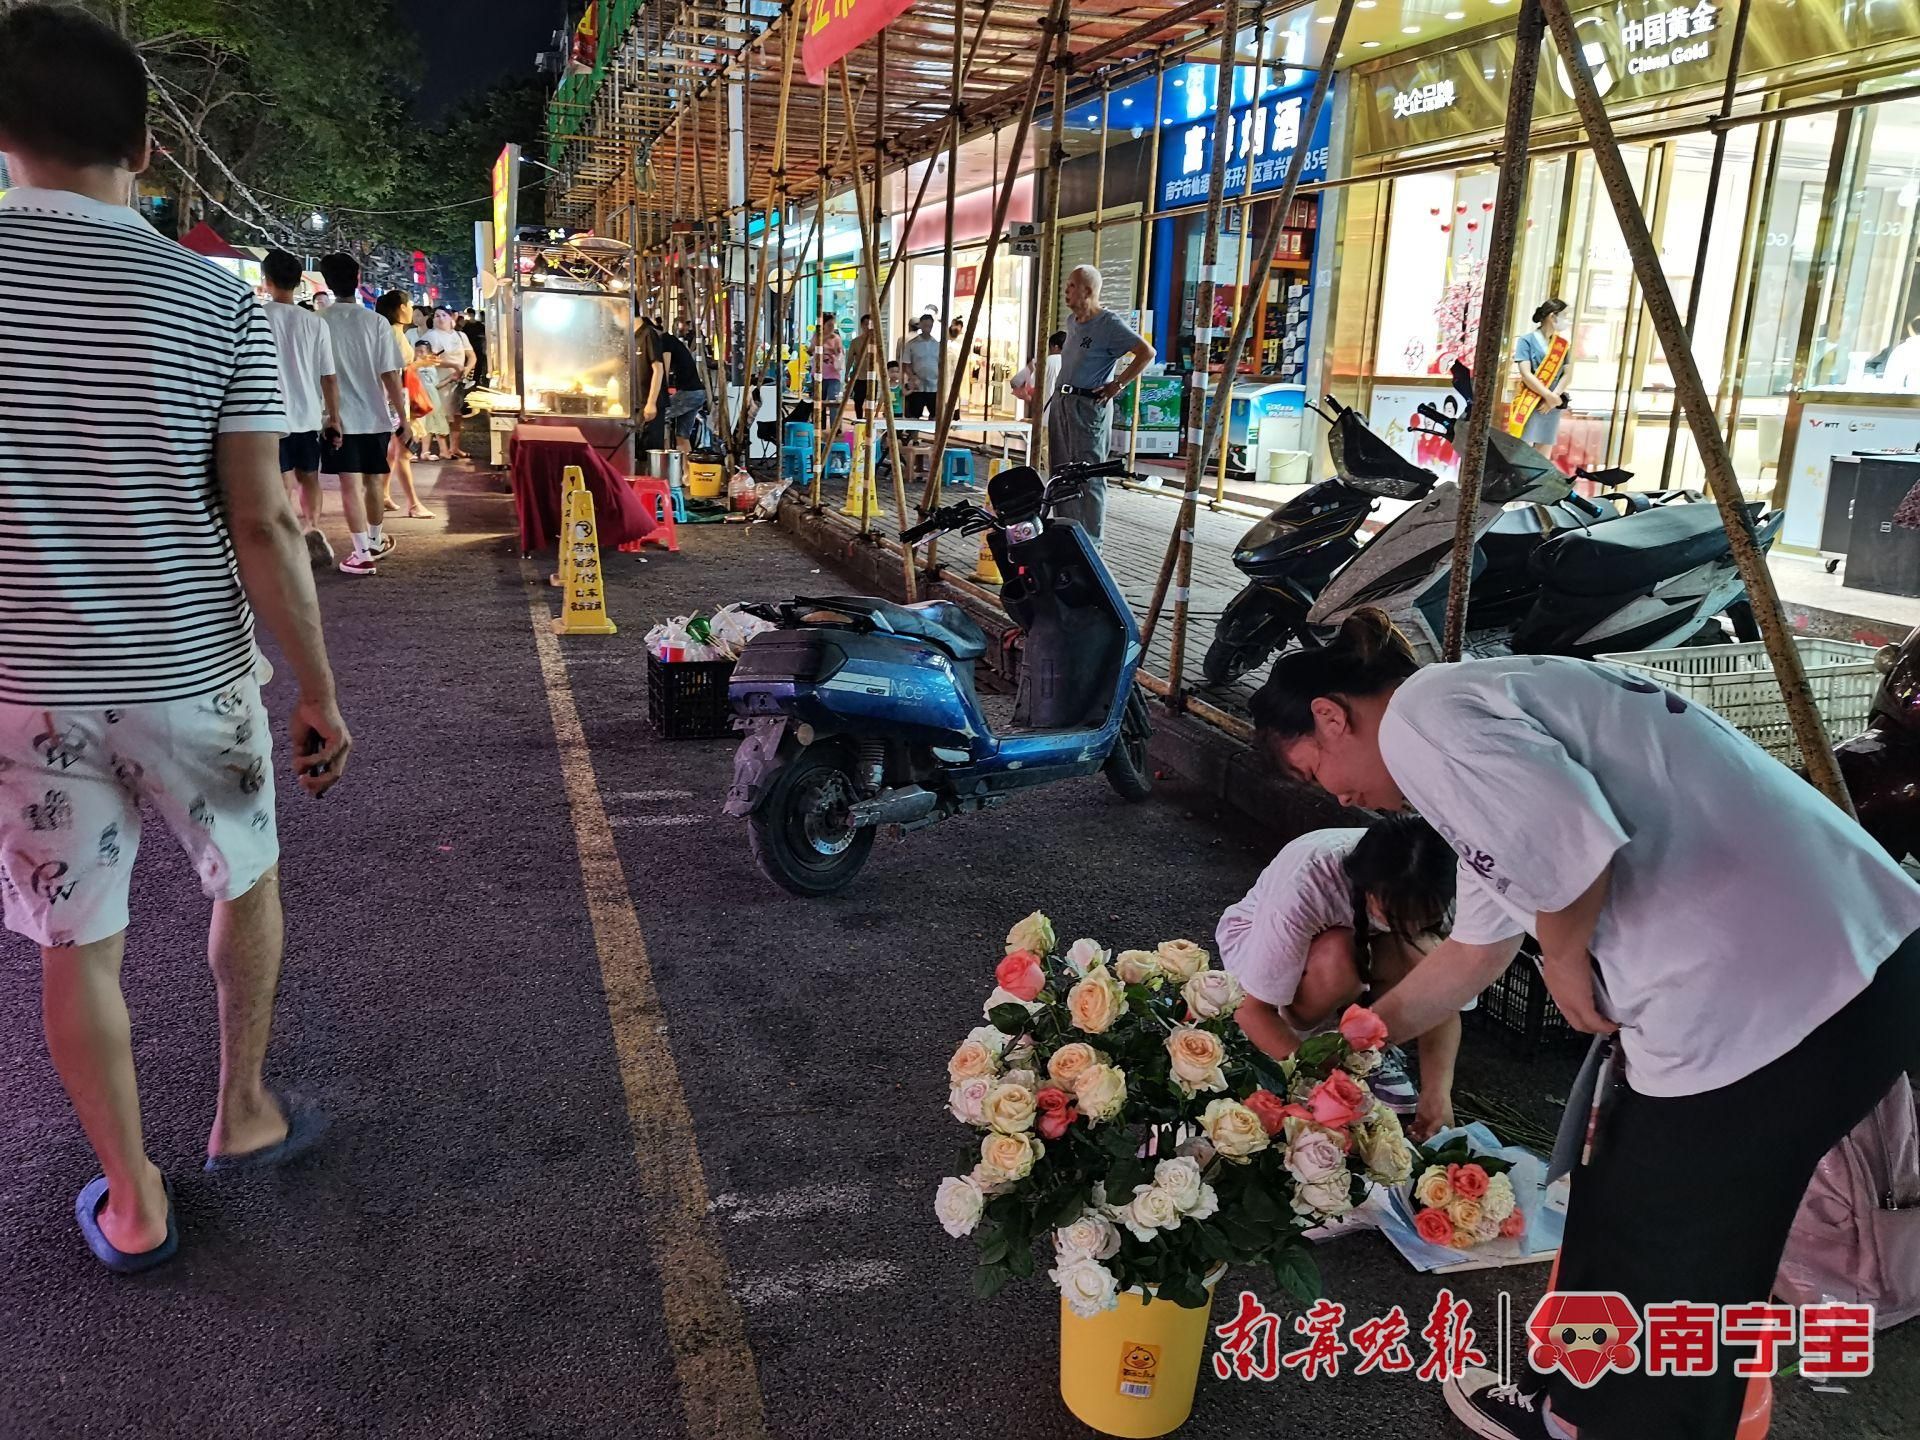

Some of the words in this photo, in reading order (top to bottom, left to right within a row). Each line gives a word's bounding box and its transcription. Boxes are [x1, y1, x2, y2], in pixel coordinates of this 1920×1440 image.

[1621, 0, 1717, 52] 中国黄金
[1628, 54, 1670, 75] China
[1671, 41, 1709, 65] Gold
[1393, 79, 1456, 119] 央企品牌
